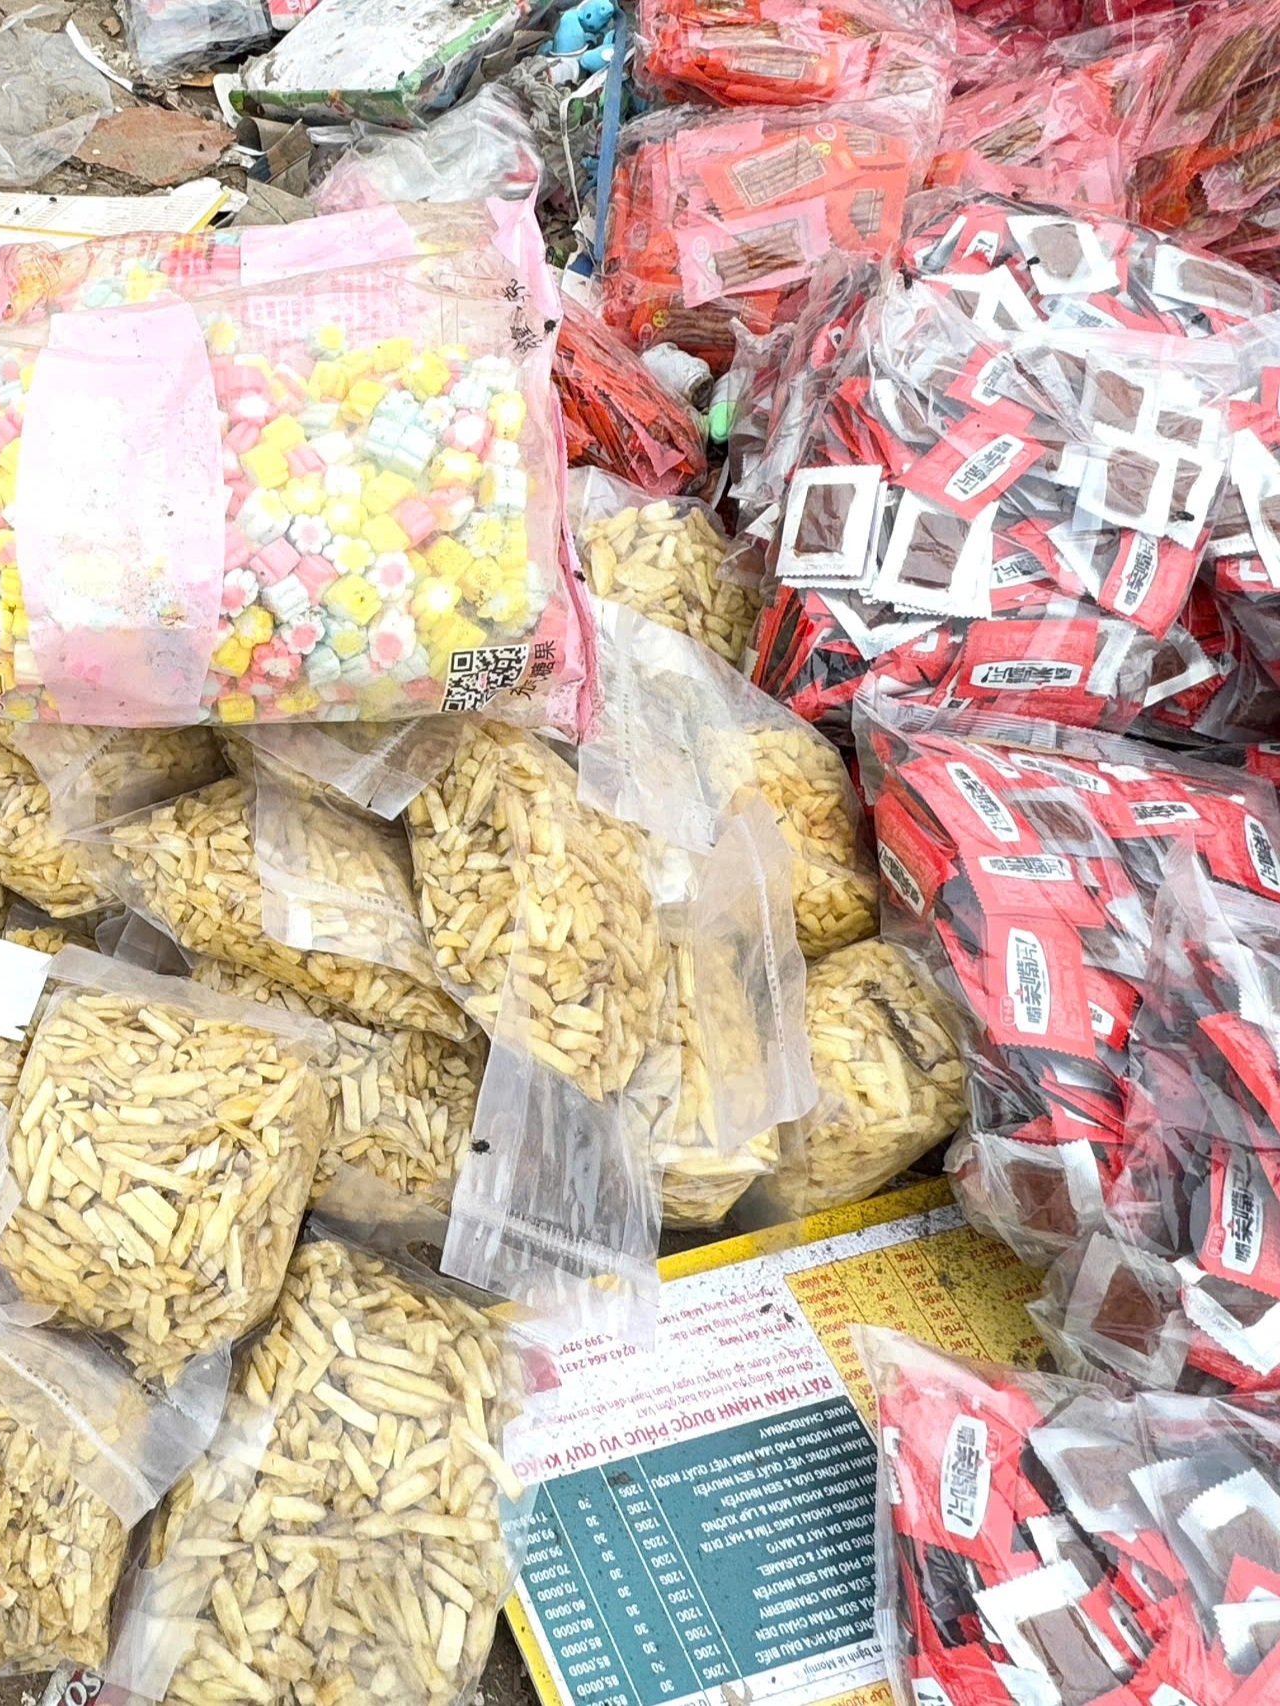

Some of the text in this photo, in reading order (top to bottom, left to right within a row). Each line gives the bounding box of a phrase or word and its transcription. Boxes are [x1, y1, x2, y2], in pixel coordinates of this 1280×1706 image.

[823, 1404, 851, 1420] VANG
[761, 1480, 784, 1494] SEN
[858, 1472, 879, 1486] ÁNH
[799, 1505, 833, 1523] KHOAI
[772, 1514, 802, 1531] LANG
[764, 1536, 797, 1553] MAYO
[755, 1553, 806, 1576] CARAMEL
[816, 1565, 838, 1579] MAI
[795, 1571, 818, 1585] SEN
[818, 1582, 849, 1600] CHUA
[757, 1591, 820, 1618] CRANBERRY
[658, 1678, 675, 1692] 30
